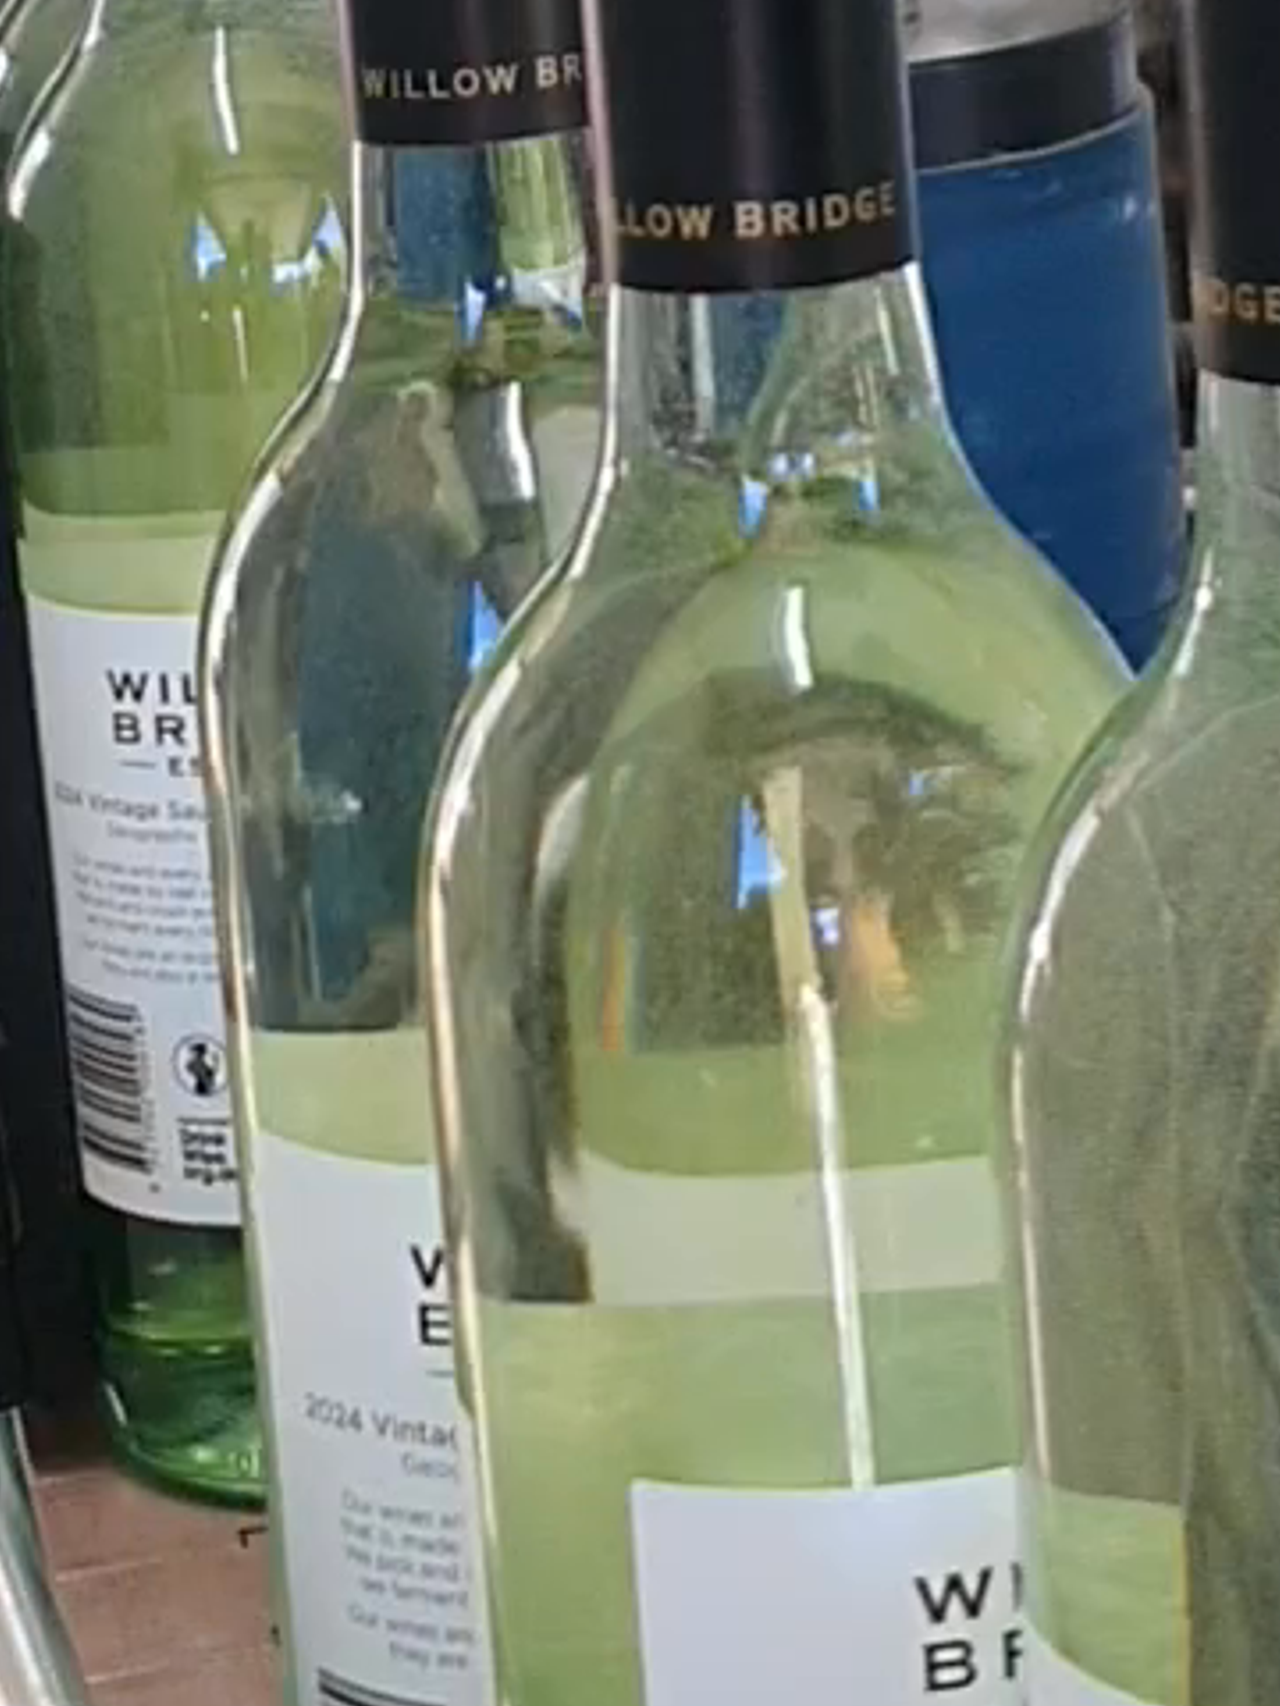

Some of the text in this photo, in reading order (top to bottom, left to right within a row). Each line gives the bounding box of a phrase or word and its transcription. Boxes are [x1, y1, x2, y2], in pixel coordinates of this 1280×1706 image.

[363, 64, 519, 99] WILLOW
[733, 181, 895, 239] BRIDGE
[112, 712, 186, 747] BR
[305, 1392, 363, 1435] 2024
